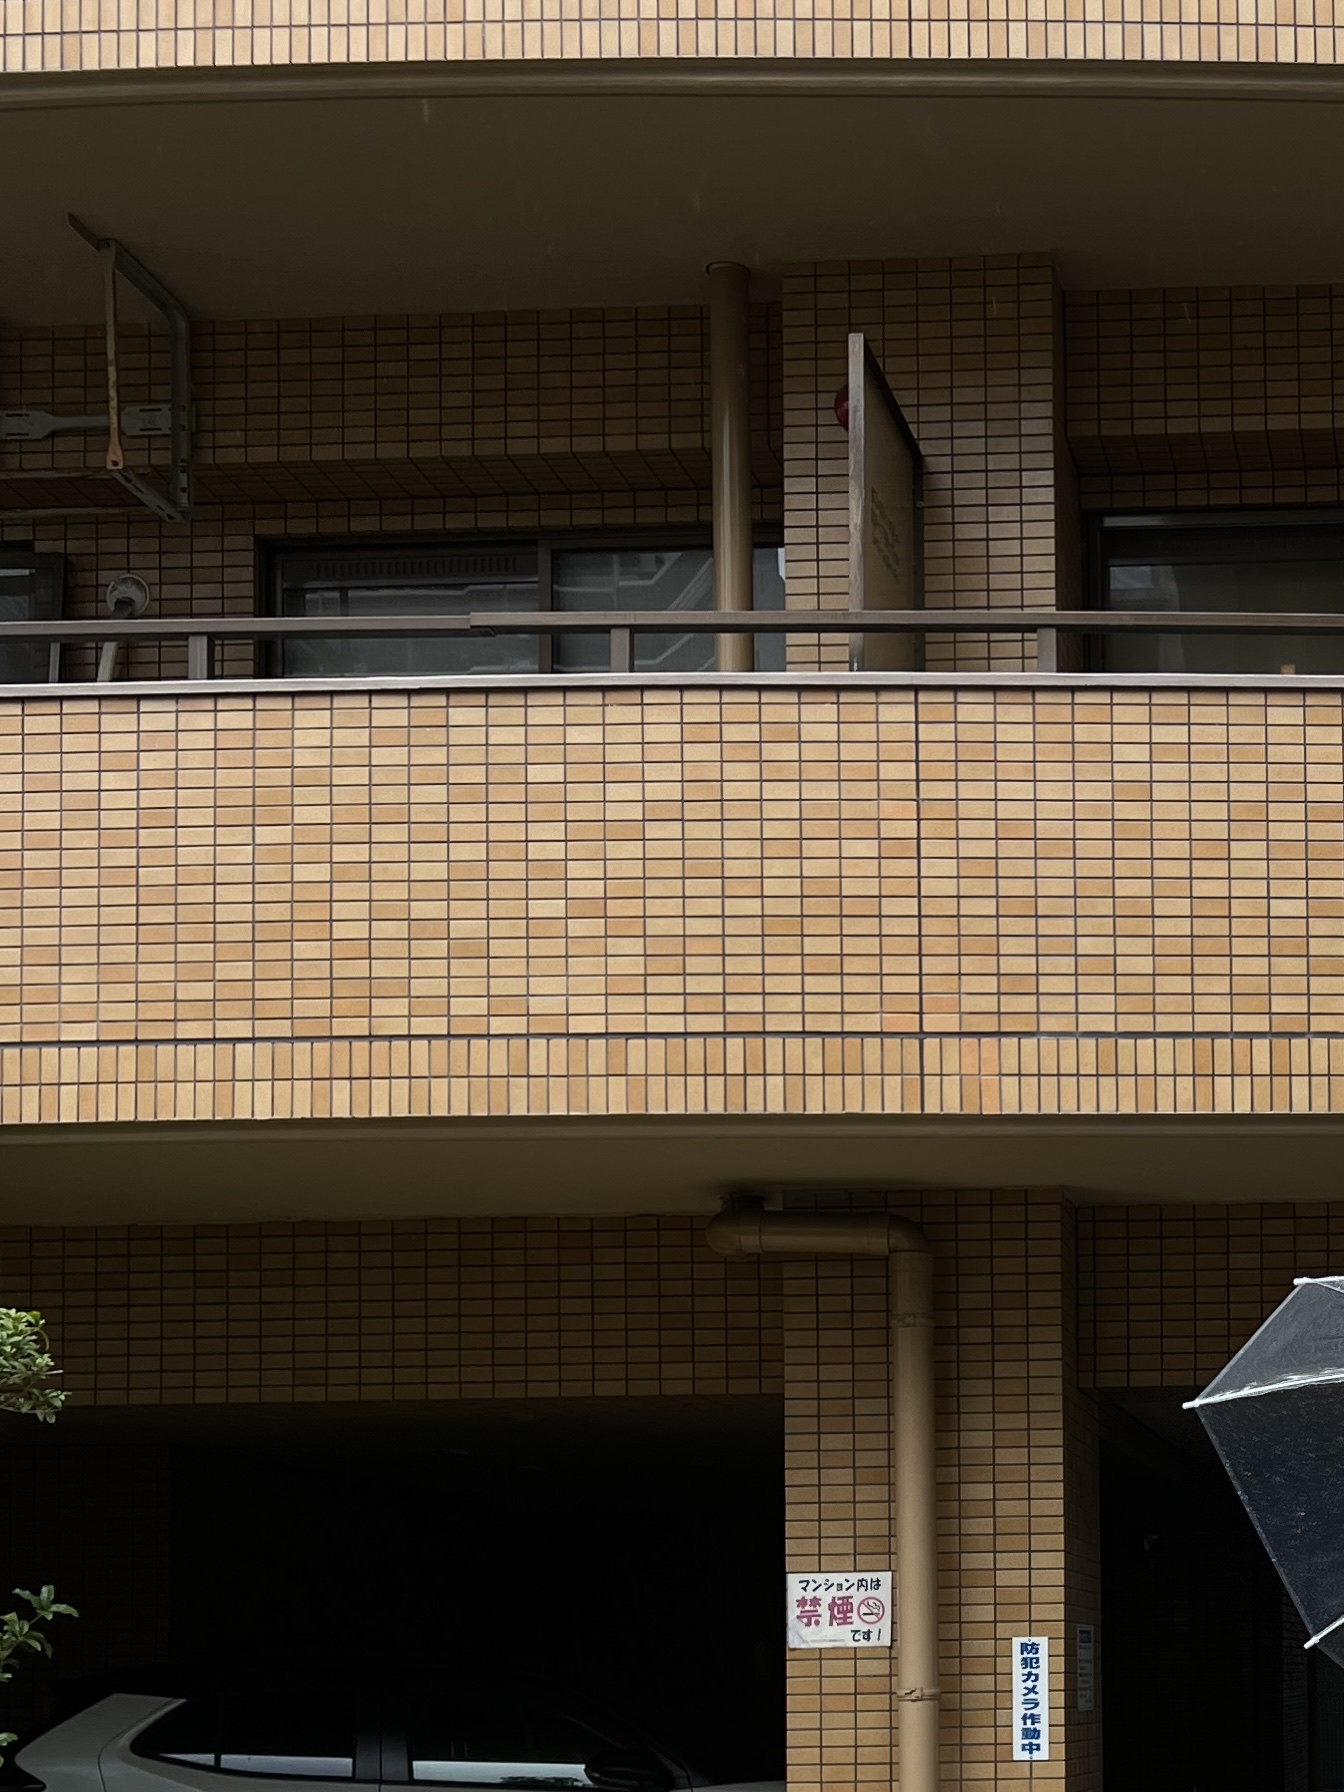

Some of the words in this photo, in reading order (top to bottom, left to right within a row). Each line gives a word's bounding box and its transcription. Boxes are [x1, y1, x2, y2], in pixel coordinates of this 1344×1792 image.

[798, 1577, 882, 1592] マンション内は
[795, 1595, 854, 1627] 禁煙
[1020, 1641, 1041, 1755] 防犯カメラ作動中
